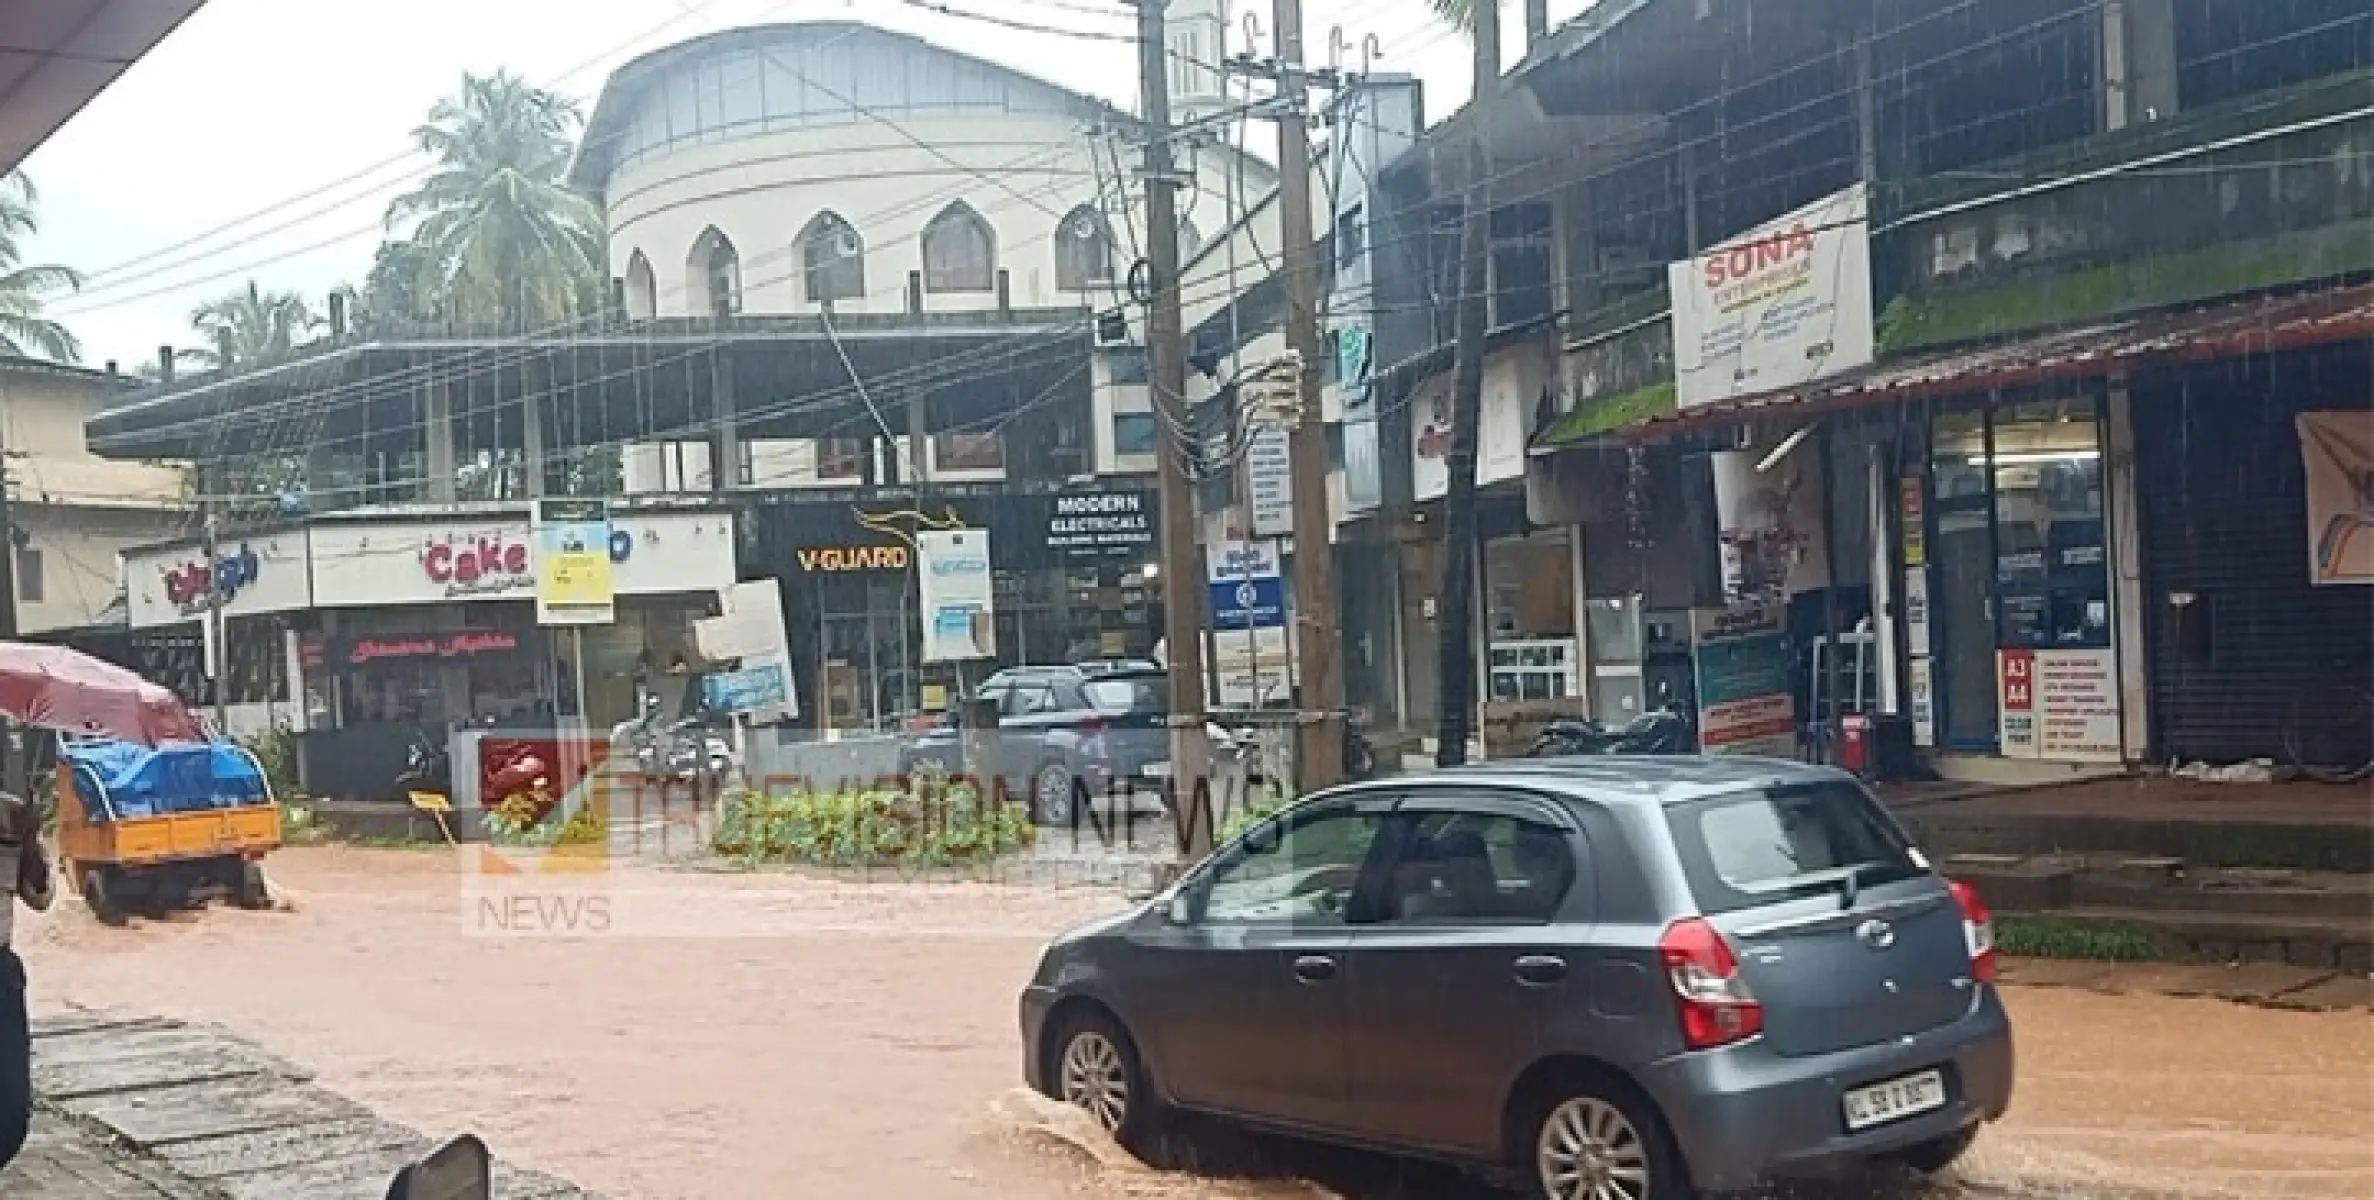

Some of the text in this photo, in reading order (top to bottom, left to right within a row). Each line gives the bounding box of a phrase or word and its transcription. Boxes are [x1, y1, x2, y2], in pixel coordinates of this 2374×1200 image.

[1705, 223, 1815, 288] SONA
[1058, 494, 1139, 514] MODERN
[1051, 514, 1148, 533] ELECTRICALS
[425, 536, 529, 583] Cake
[797, 546, 908, 572] V-GUARD
[2006, 658, 2026, 677] A3
[2006, 683, 2029, 703] A4
